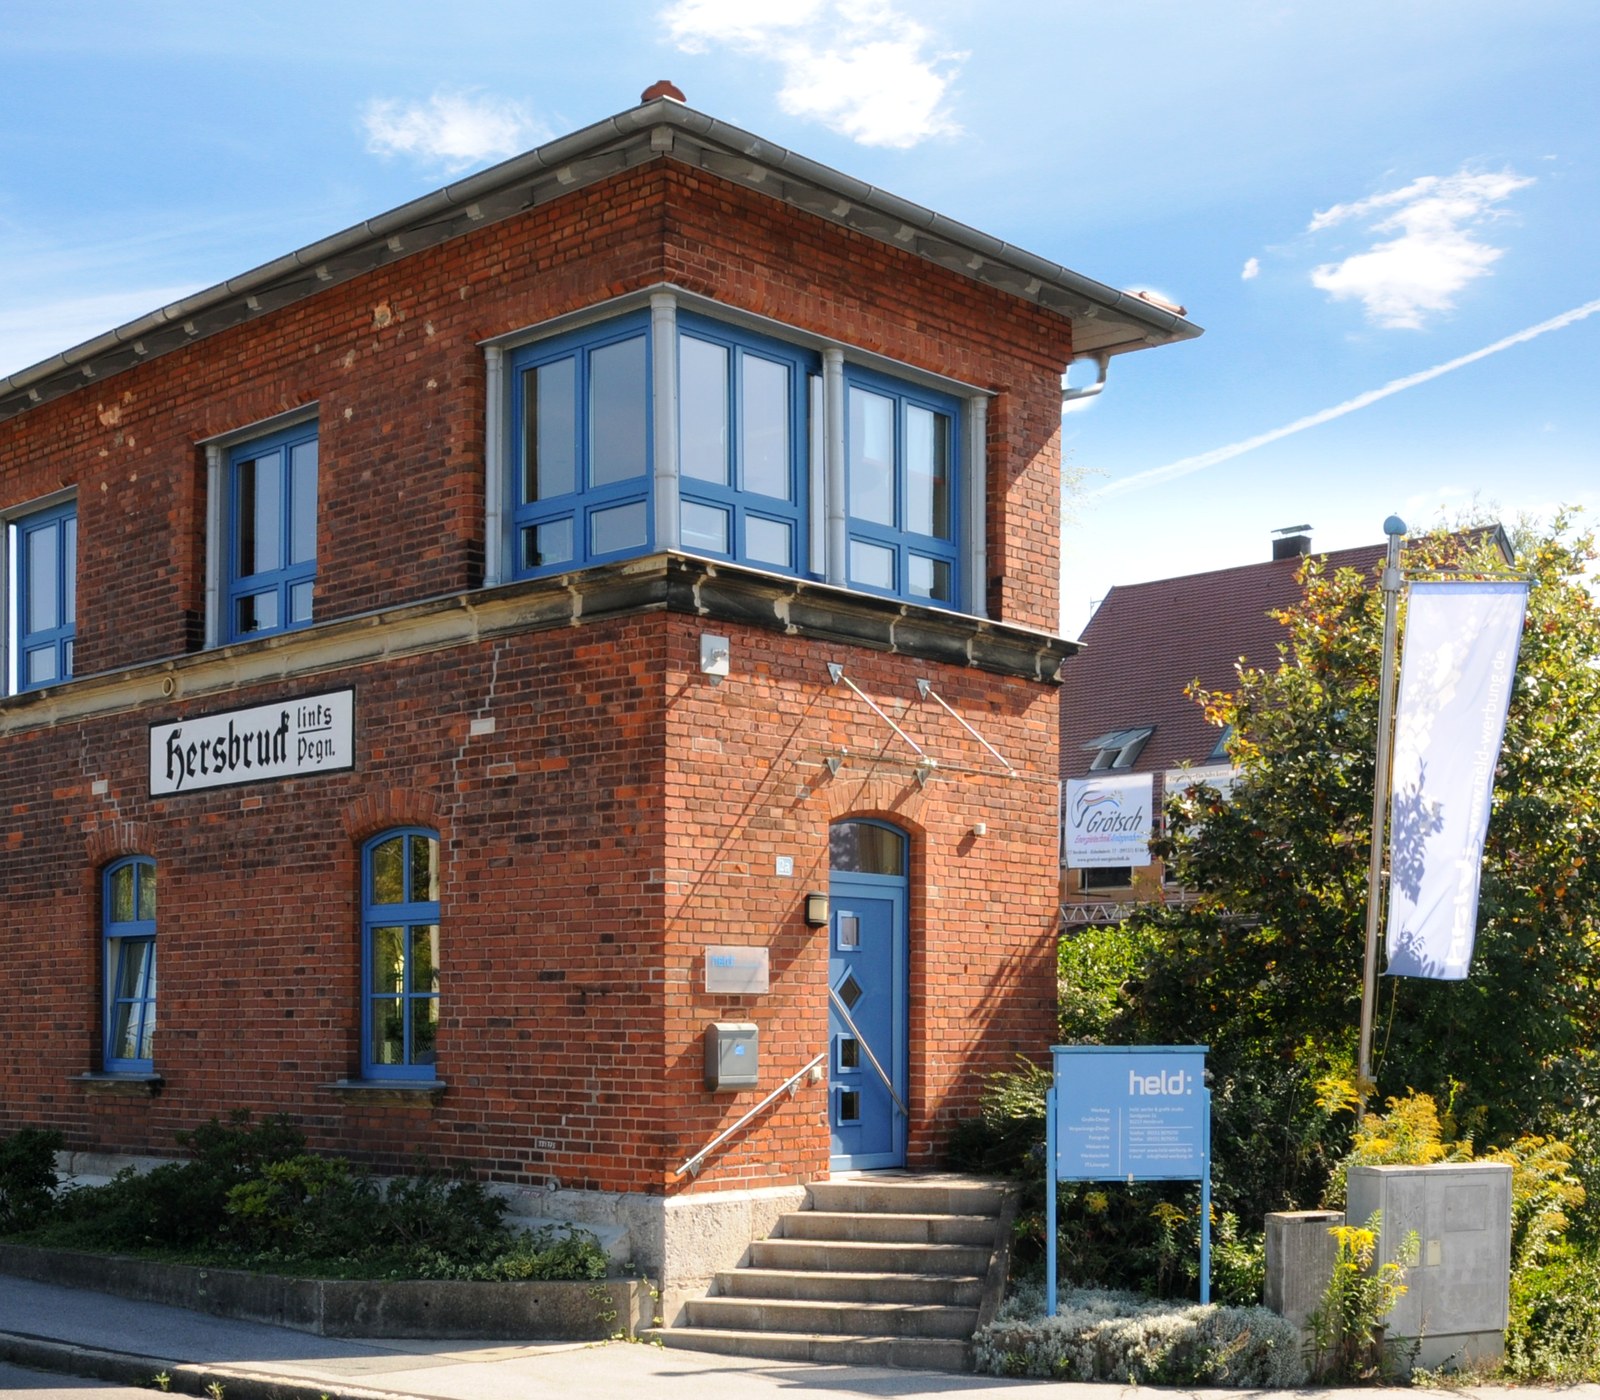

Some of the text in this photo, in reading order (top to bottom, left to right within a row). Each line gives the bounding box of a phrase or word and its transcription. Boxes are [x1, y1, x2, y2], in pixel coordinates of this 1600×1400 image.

[165, 704, 332, 790] Hersbruck links
[1086, 805, 1143, 833] Grötsch
[1129, 1069, 1192, 1096] held:
